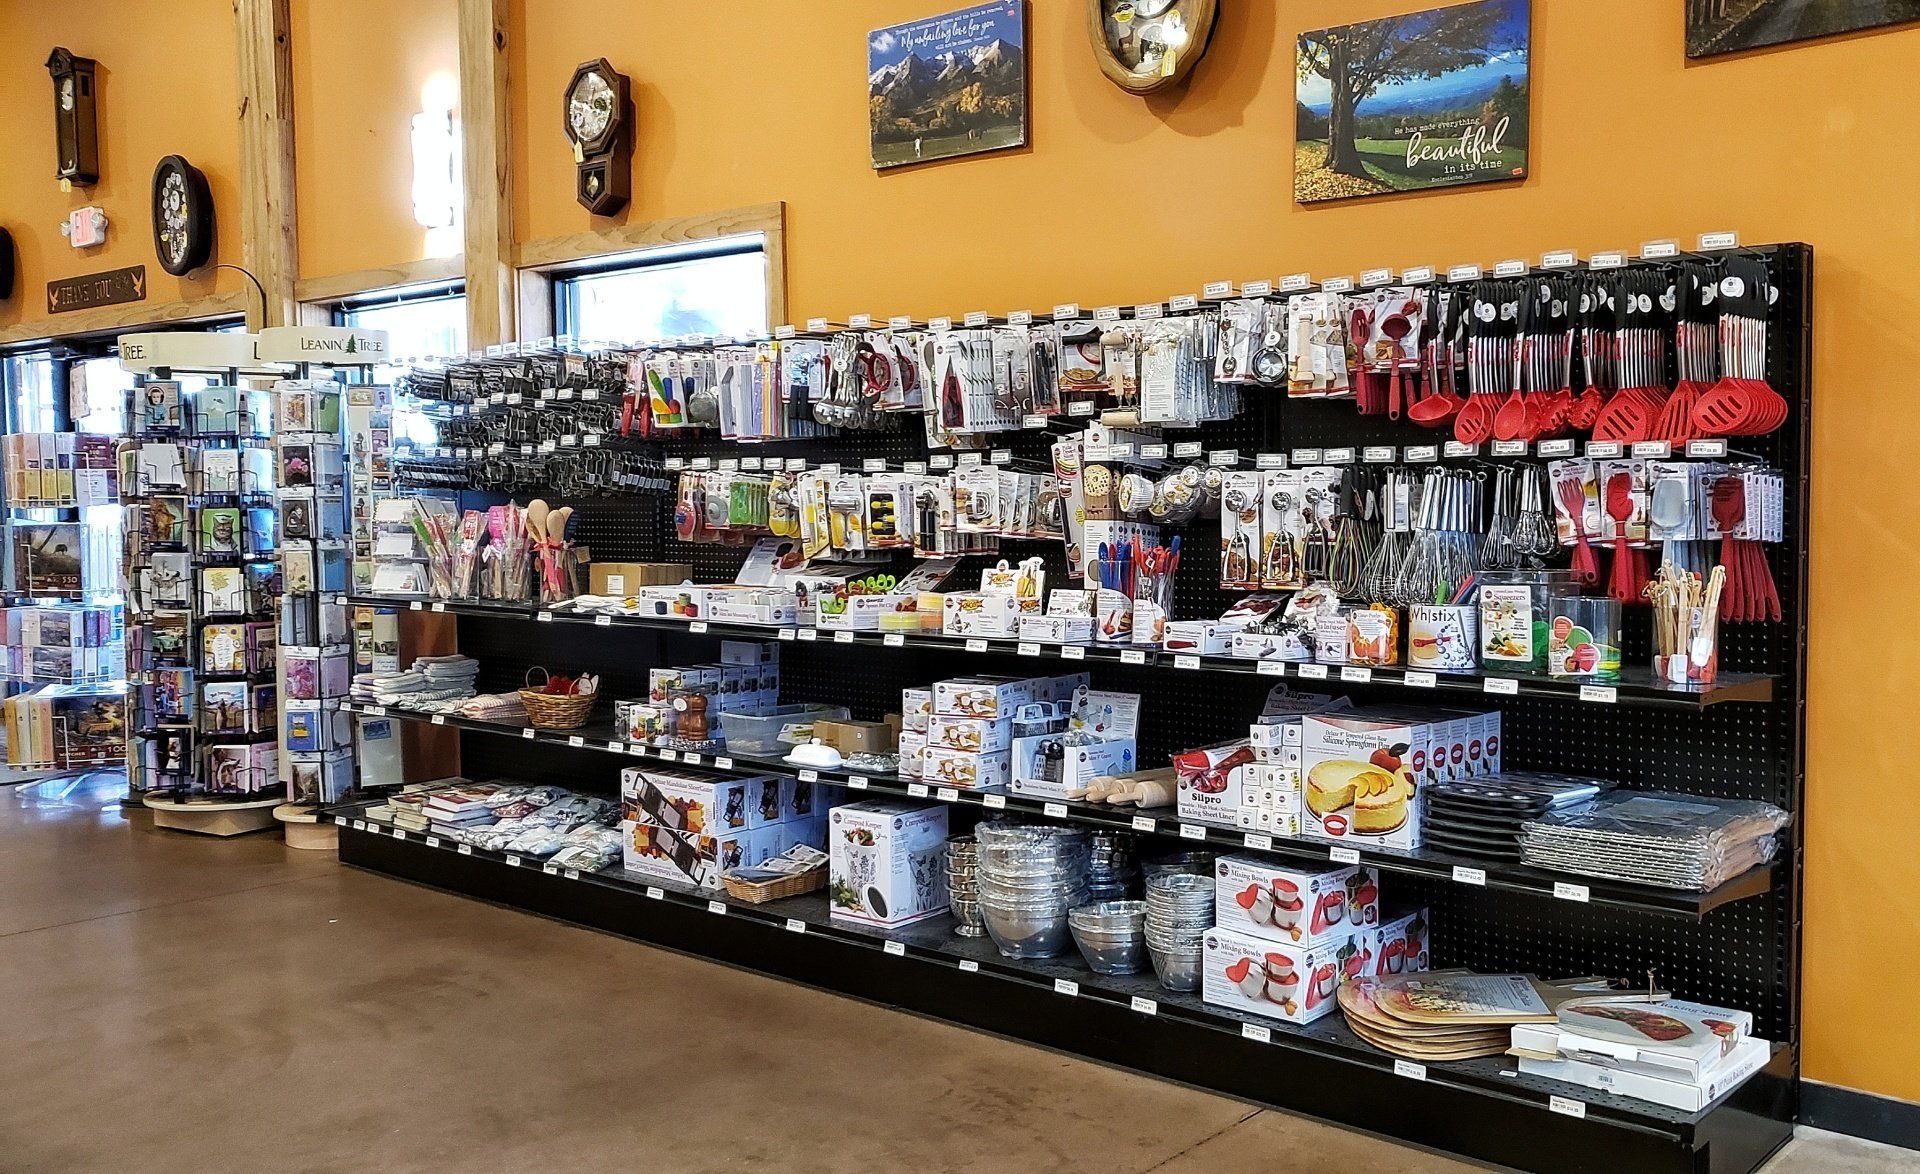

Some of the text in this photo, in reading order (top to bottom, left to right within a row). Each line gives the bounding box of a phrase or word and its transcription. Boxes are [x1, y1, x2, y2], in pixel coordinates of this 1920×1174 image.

[901, 18, 995, 52] My unfailing love for you
[1394, 118, 1480, 135] He has made everything
[1406, 115, 1510, 168] beautiful
[1443, 160, 1502, 174] in its time
[357, 338, 382, 352] TREE
[1494, 594, 1526, 602] Squeezers
[1285, 690, 1315, 700] Silpro
[1322, 736, 1345, 746] Silicone
[1345, 738, 1377, 750] Springform
[1192, 793, 1222, 804] Silpro
[1182, 807, 1235, 820] Baking Sheet Liner
[865, 821, 882, 830] Keeper
[905, 817, 925, 828] Compost
[1231, 869, 1269, 884] Mixing Bowls
[1220, 943, 1262, 957] Mixing Bowls
[1660, 1002, 1700, 1014] Baking
